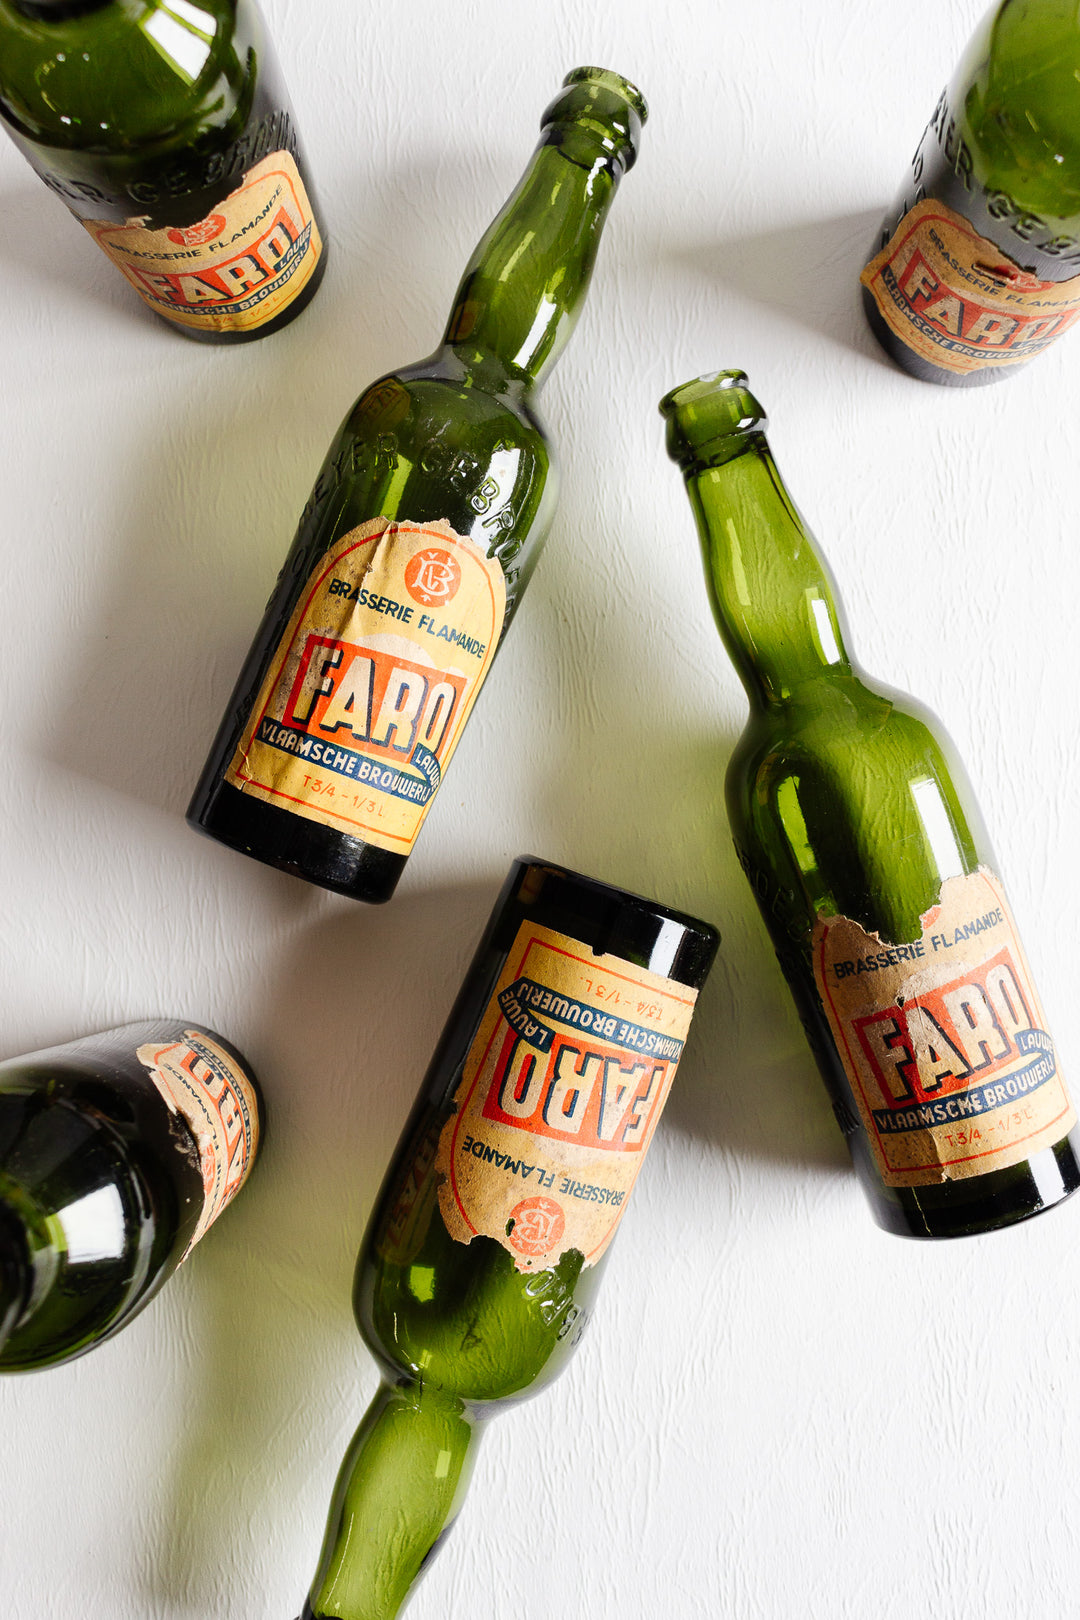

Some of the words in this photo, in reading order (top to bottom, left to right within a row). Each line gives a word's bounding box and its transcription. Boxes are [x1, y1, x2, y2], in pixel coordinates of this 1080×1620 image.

[208, 184, 283, 252] FLAMANDE
[138, 221, 293, 304] FARO
[929, 228, 1001, 296] BRASSERIE
[902, 263, 1065, 346] FARO
[327, 578, 414, 625] BRASSERIE
[417, 614, 487, 659] FLAMANDE
[291, 644, 458, 755] FARO
[262, 721, 358, 775] VLAAMSCHE
[358, 761, 431, 802] BROUWERIJ
[833, 941, 926, 980] BRASSERIE
[931, 907, 1004, 952] FLAMANDE
[500, 990, 549, 1046] LAUWE
[517, 982, 618, 1037] BROUWERIJ
[617, 1023, 683, 1060] VLAAMSCHE
[861, 963, 1033, 1101] FARO
[497, 1043, 665, 1144] FARO
[983, 1054, 1055, 1108] BROUWERIJ
[461, 1135, 556, 1189] FLAMANDE
[558, 1177, 626, 1206] BRASSERIE
